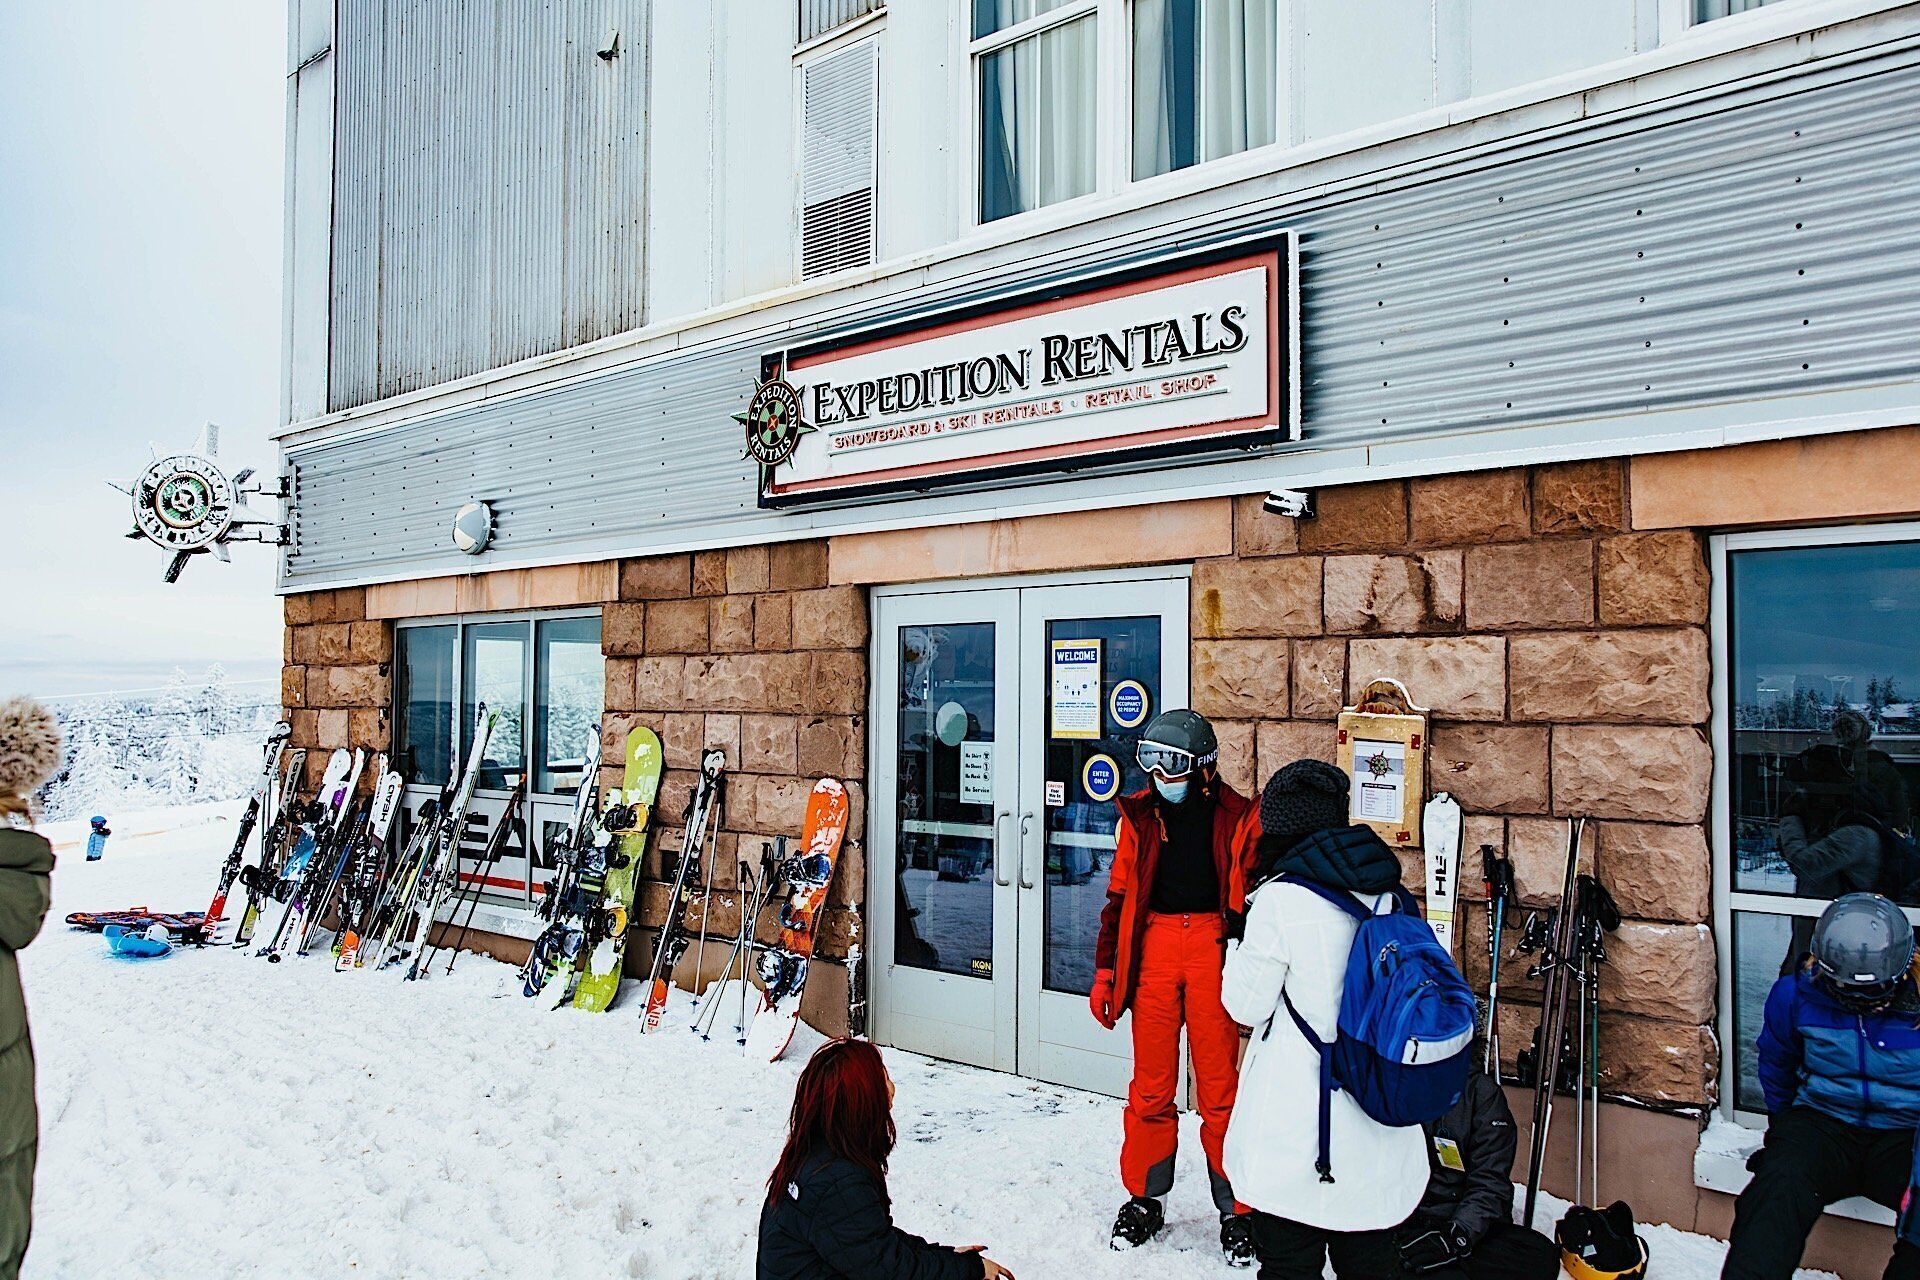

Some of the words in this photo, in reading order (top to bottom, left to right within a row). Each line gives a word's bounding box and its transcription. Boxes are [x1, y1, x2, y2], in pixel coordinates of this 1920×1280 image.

[811, 348, 1031, 426] EXPEDITION
[1040, 304, 1249, 386] RENTALS
[751, 385, 797, 428] EXPEDITION
[834, 421, 931, 449] SNOWBOARD
[933, 420, 945, 432] &
[949, 413, 976, 430] SKI
[982, 399, 1062, 425] RENTALS
[1085, 384, 1152, 408] RETAIL
[1160, 373, 1217, 396] SHOP
[750, 433, 791, 461] RENTALS
[1056, 650, 1096, 662] WELCOME
[1092, 770, 1109, 778] ENTER
[380, 784, 395, 822] HEAD
[1435, 855, 1447, 896] HE
[972, 959, 992, 971] IKON
